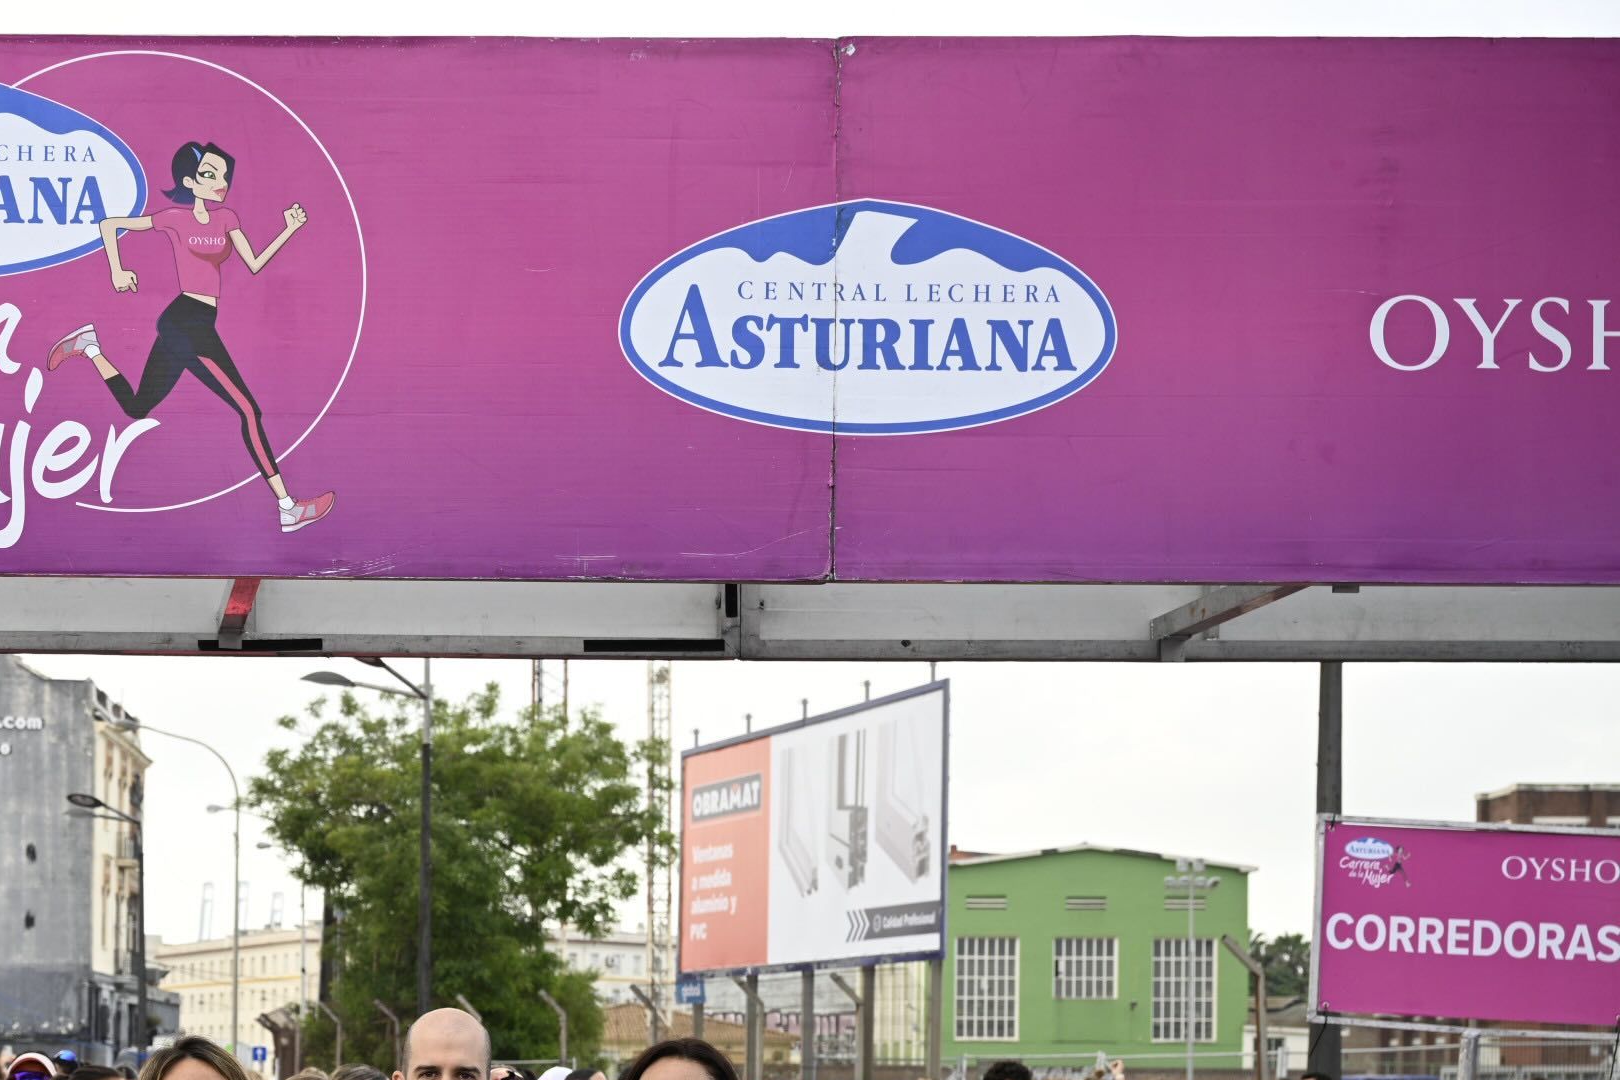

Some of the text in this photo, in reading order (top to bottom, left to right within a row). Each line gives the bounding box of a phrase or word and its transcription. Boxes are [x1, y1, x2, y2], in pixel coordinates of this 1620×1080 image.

[188, 236, 226, 246] OYSHO
[737, 280, 1061, 304] CENTRAL LECHERA
[658, 283, 1077, 373] ASTURIANA
[692, 780, 761, 819] OBRAMAT
[1501, 855, 1620, 884] OYSHO
[1325, 912, 1620, 963] CORREDORAS
